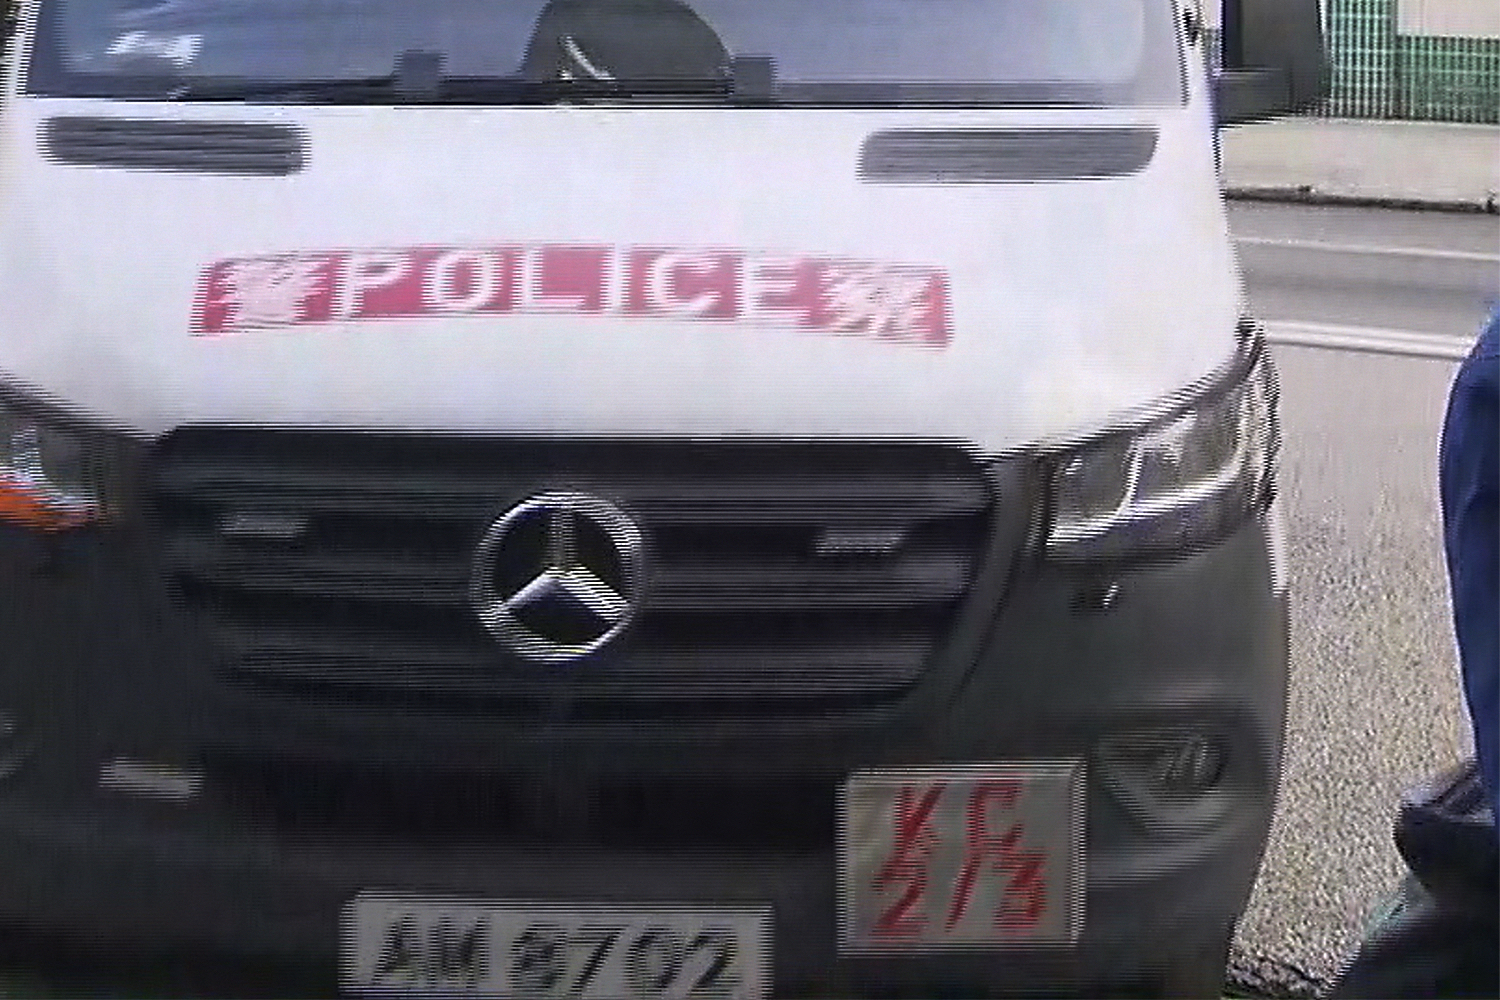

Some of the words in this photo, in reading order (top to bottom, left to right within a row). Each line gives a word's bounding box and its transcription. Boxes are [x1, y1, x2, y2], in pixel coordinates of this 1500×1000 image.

[332, 249, 818, 322] POLICE
[372, 910, 490, 992] AM
[506, 922, 738, 1000] 8702
